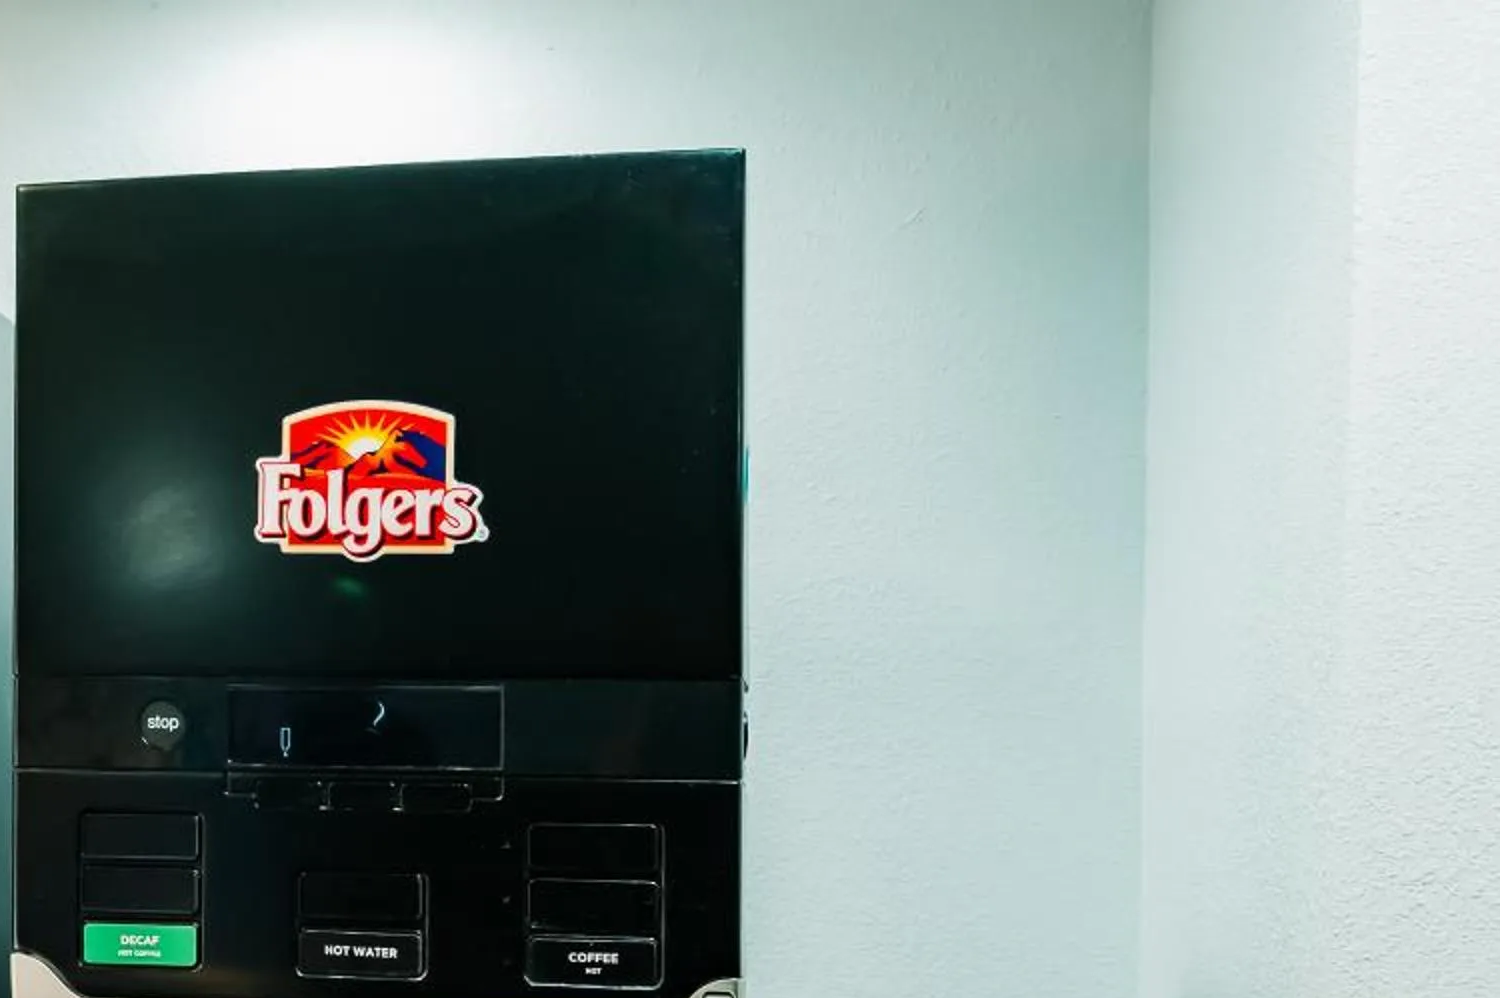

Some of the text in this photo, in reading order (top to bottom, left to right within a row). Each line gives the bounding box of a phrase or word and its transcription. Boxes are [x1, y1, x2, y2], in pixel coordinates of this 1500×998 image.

[257, 461, 477, 557] Folgers
[147, 715, 180, 733] stop
[119, 934, 161, 946] DECAF
[323, 944, 399, 960] HOT WATER
[567, 951, 620, 965] COFFEE
